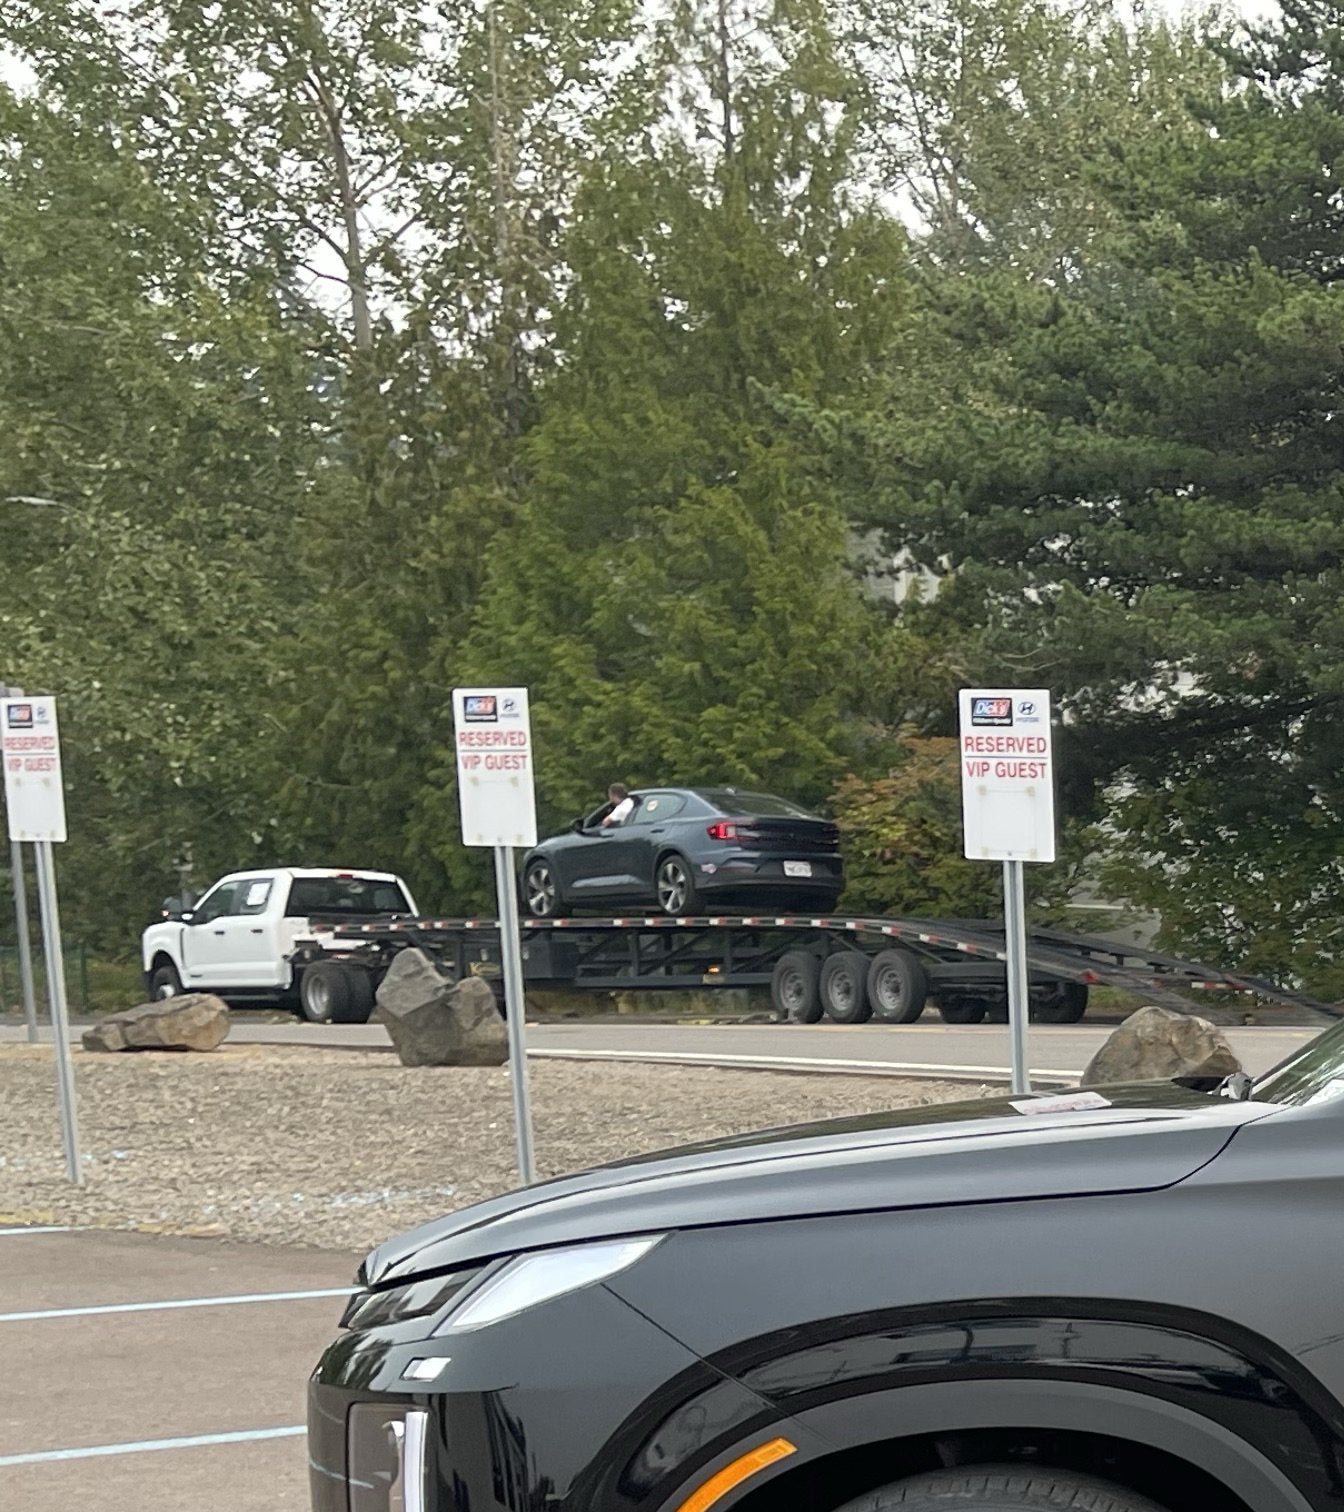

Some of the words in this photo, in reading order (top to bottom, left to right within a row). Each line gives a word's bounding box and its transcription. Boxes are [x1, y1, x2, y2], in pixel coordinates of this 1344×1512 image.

[459, 730, 527, 747] RESERVED
[965, 735, 1047, 754] RESERVED
[461, 754, 481, 770] VIP
[485, 754, 528, 771] GUEST
[966, 761, 990, 778] VIP
[995, 761, 1047, 779] GUEST
